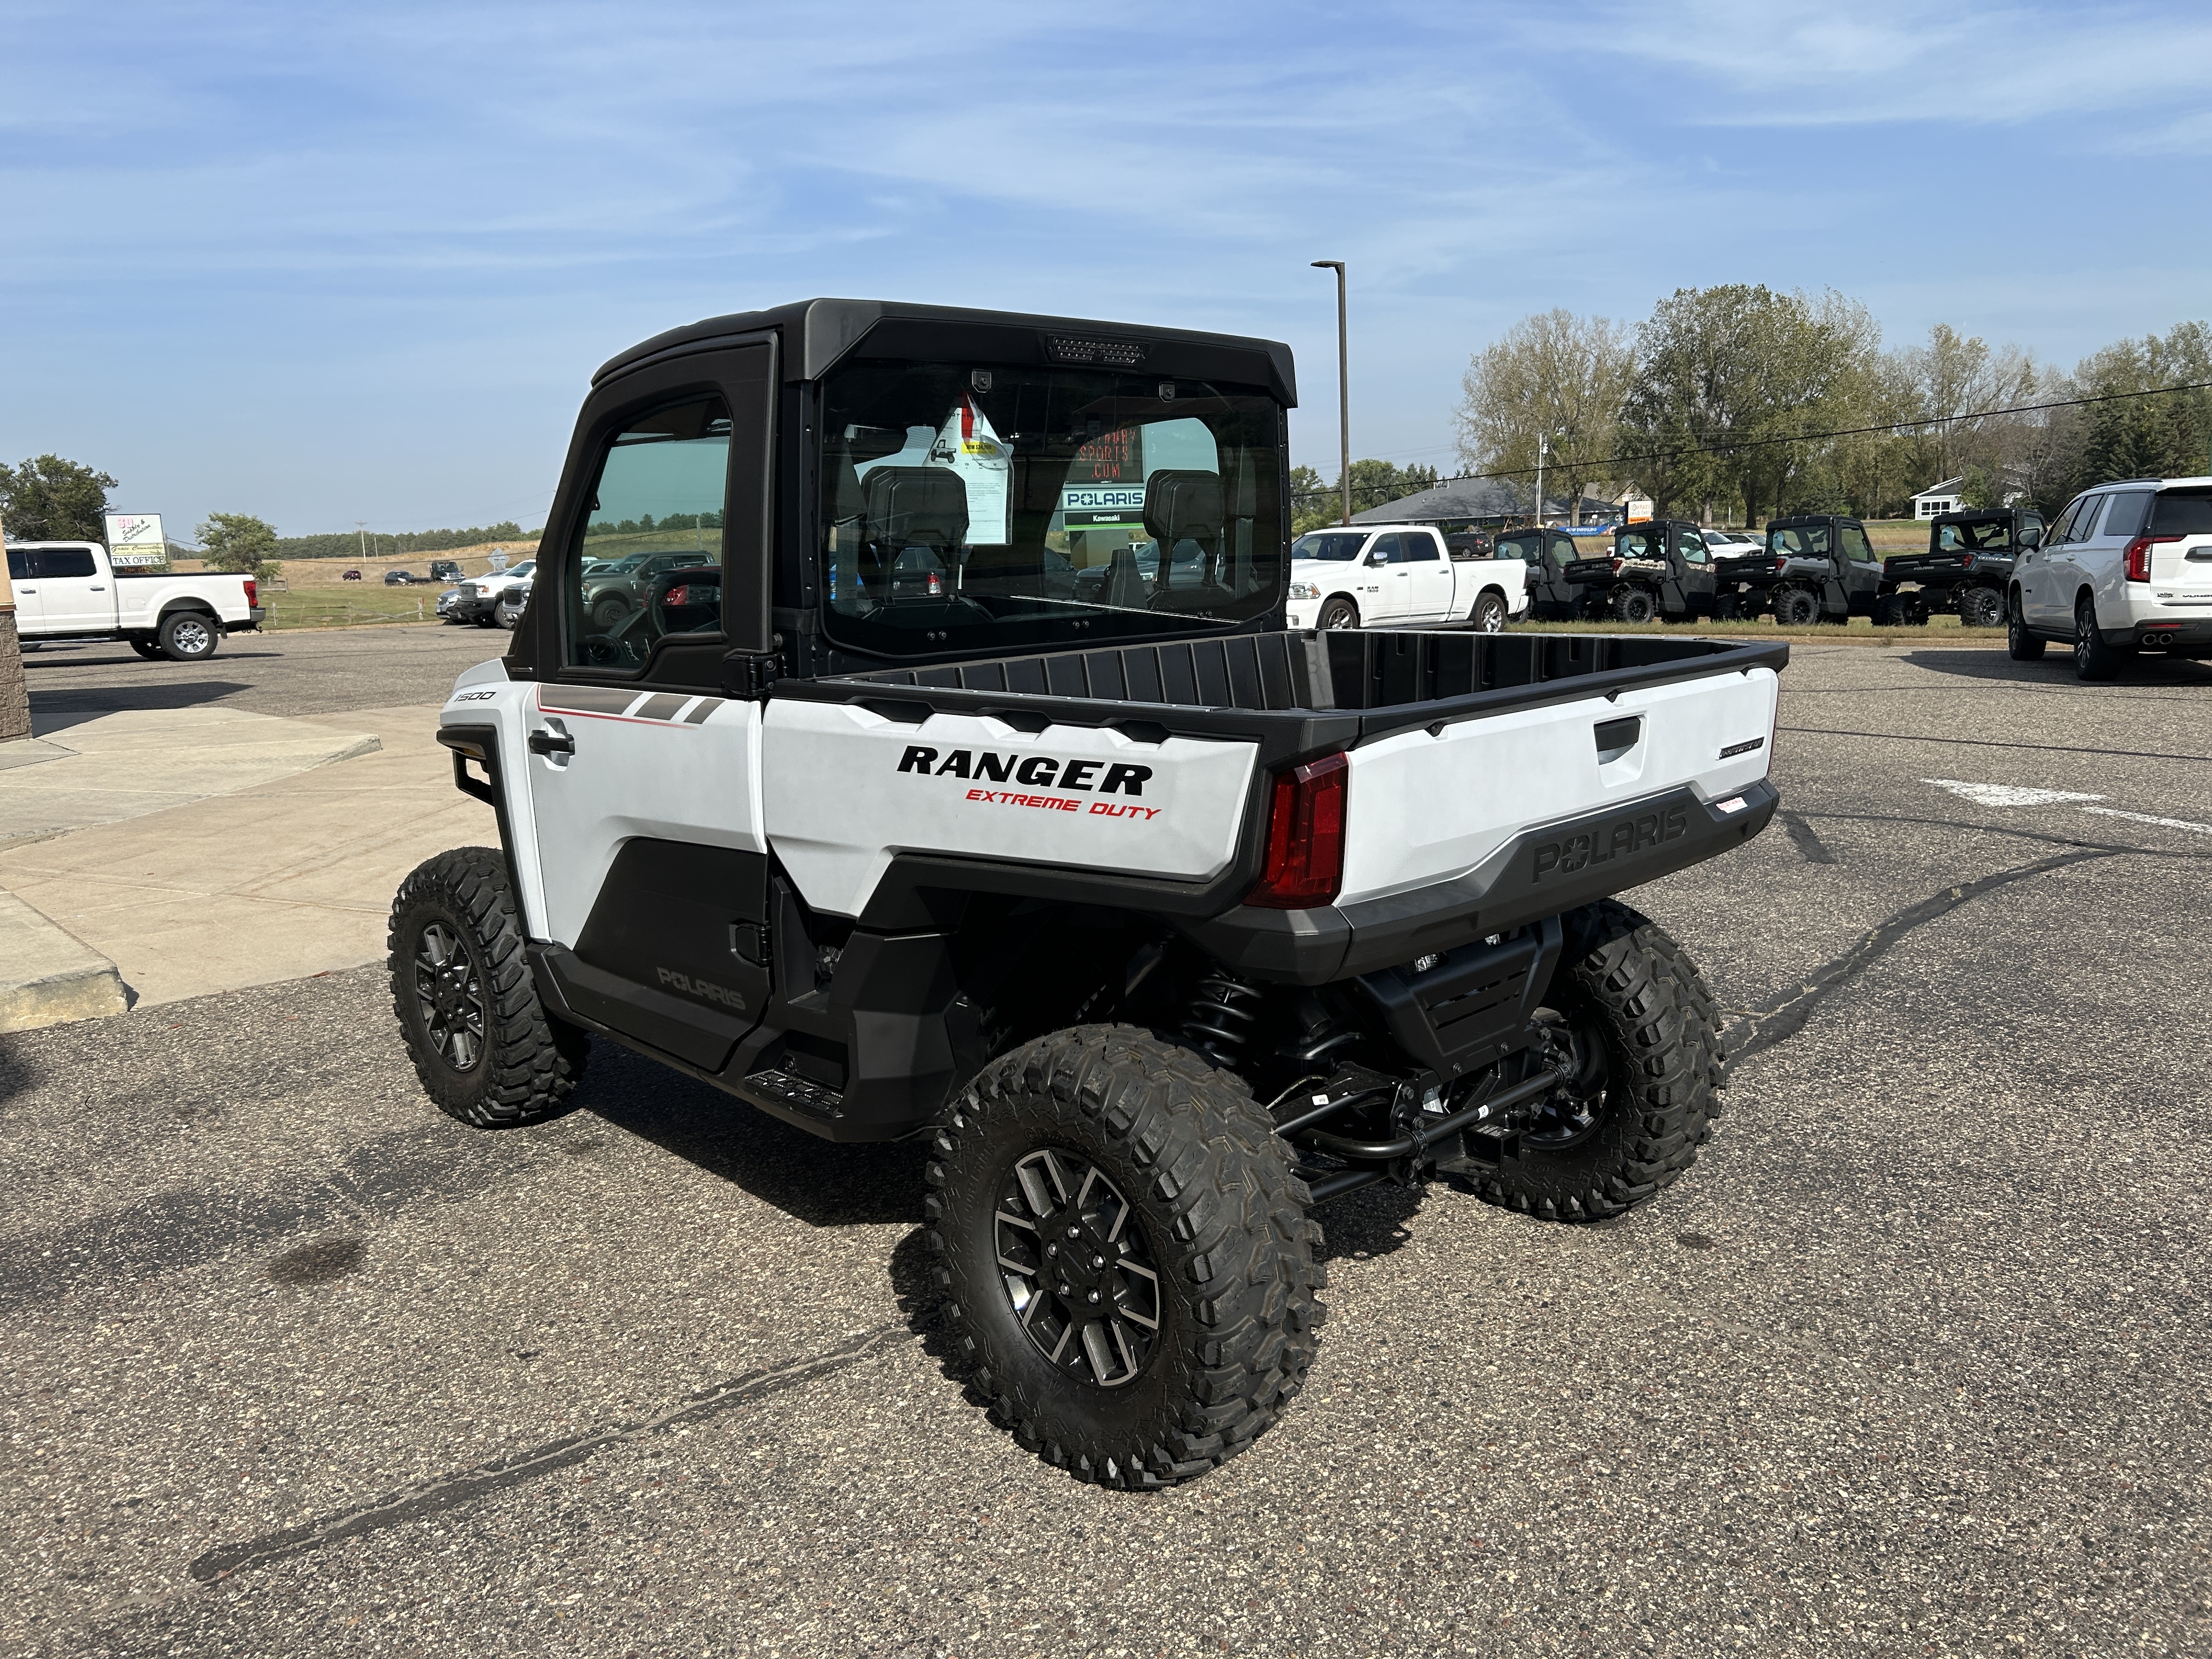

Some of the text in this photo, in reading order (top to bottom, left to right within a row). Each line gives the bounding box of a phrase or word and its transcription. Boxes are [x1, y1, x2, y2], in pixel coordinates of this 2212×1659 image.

[1079, 445, 1128, 461] SPORTS
[1068, 492, 1143, 506] POLARIS
[133, 556, 165, 565] OFFICE
[454, 691, 497, 702] 1500
[896, 745, 1153, 797] RANGER
[966, 789, 1163, 820] EXTREME DUTY
[1532, 804, 1687, 884] POLARIS
[657, 966, 746, 1011] POLARIS
